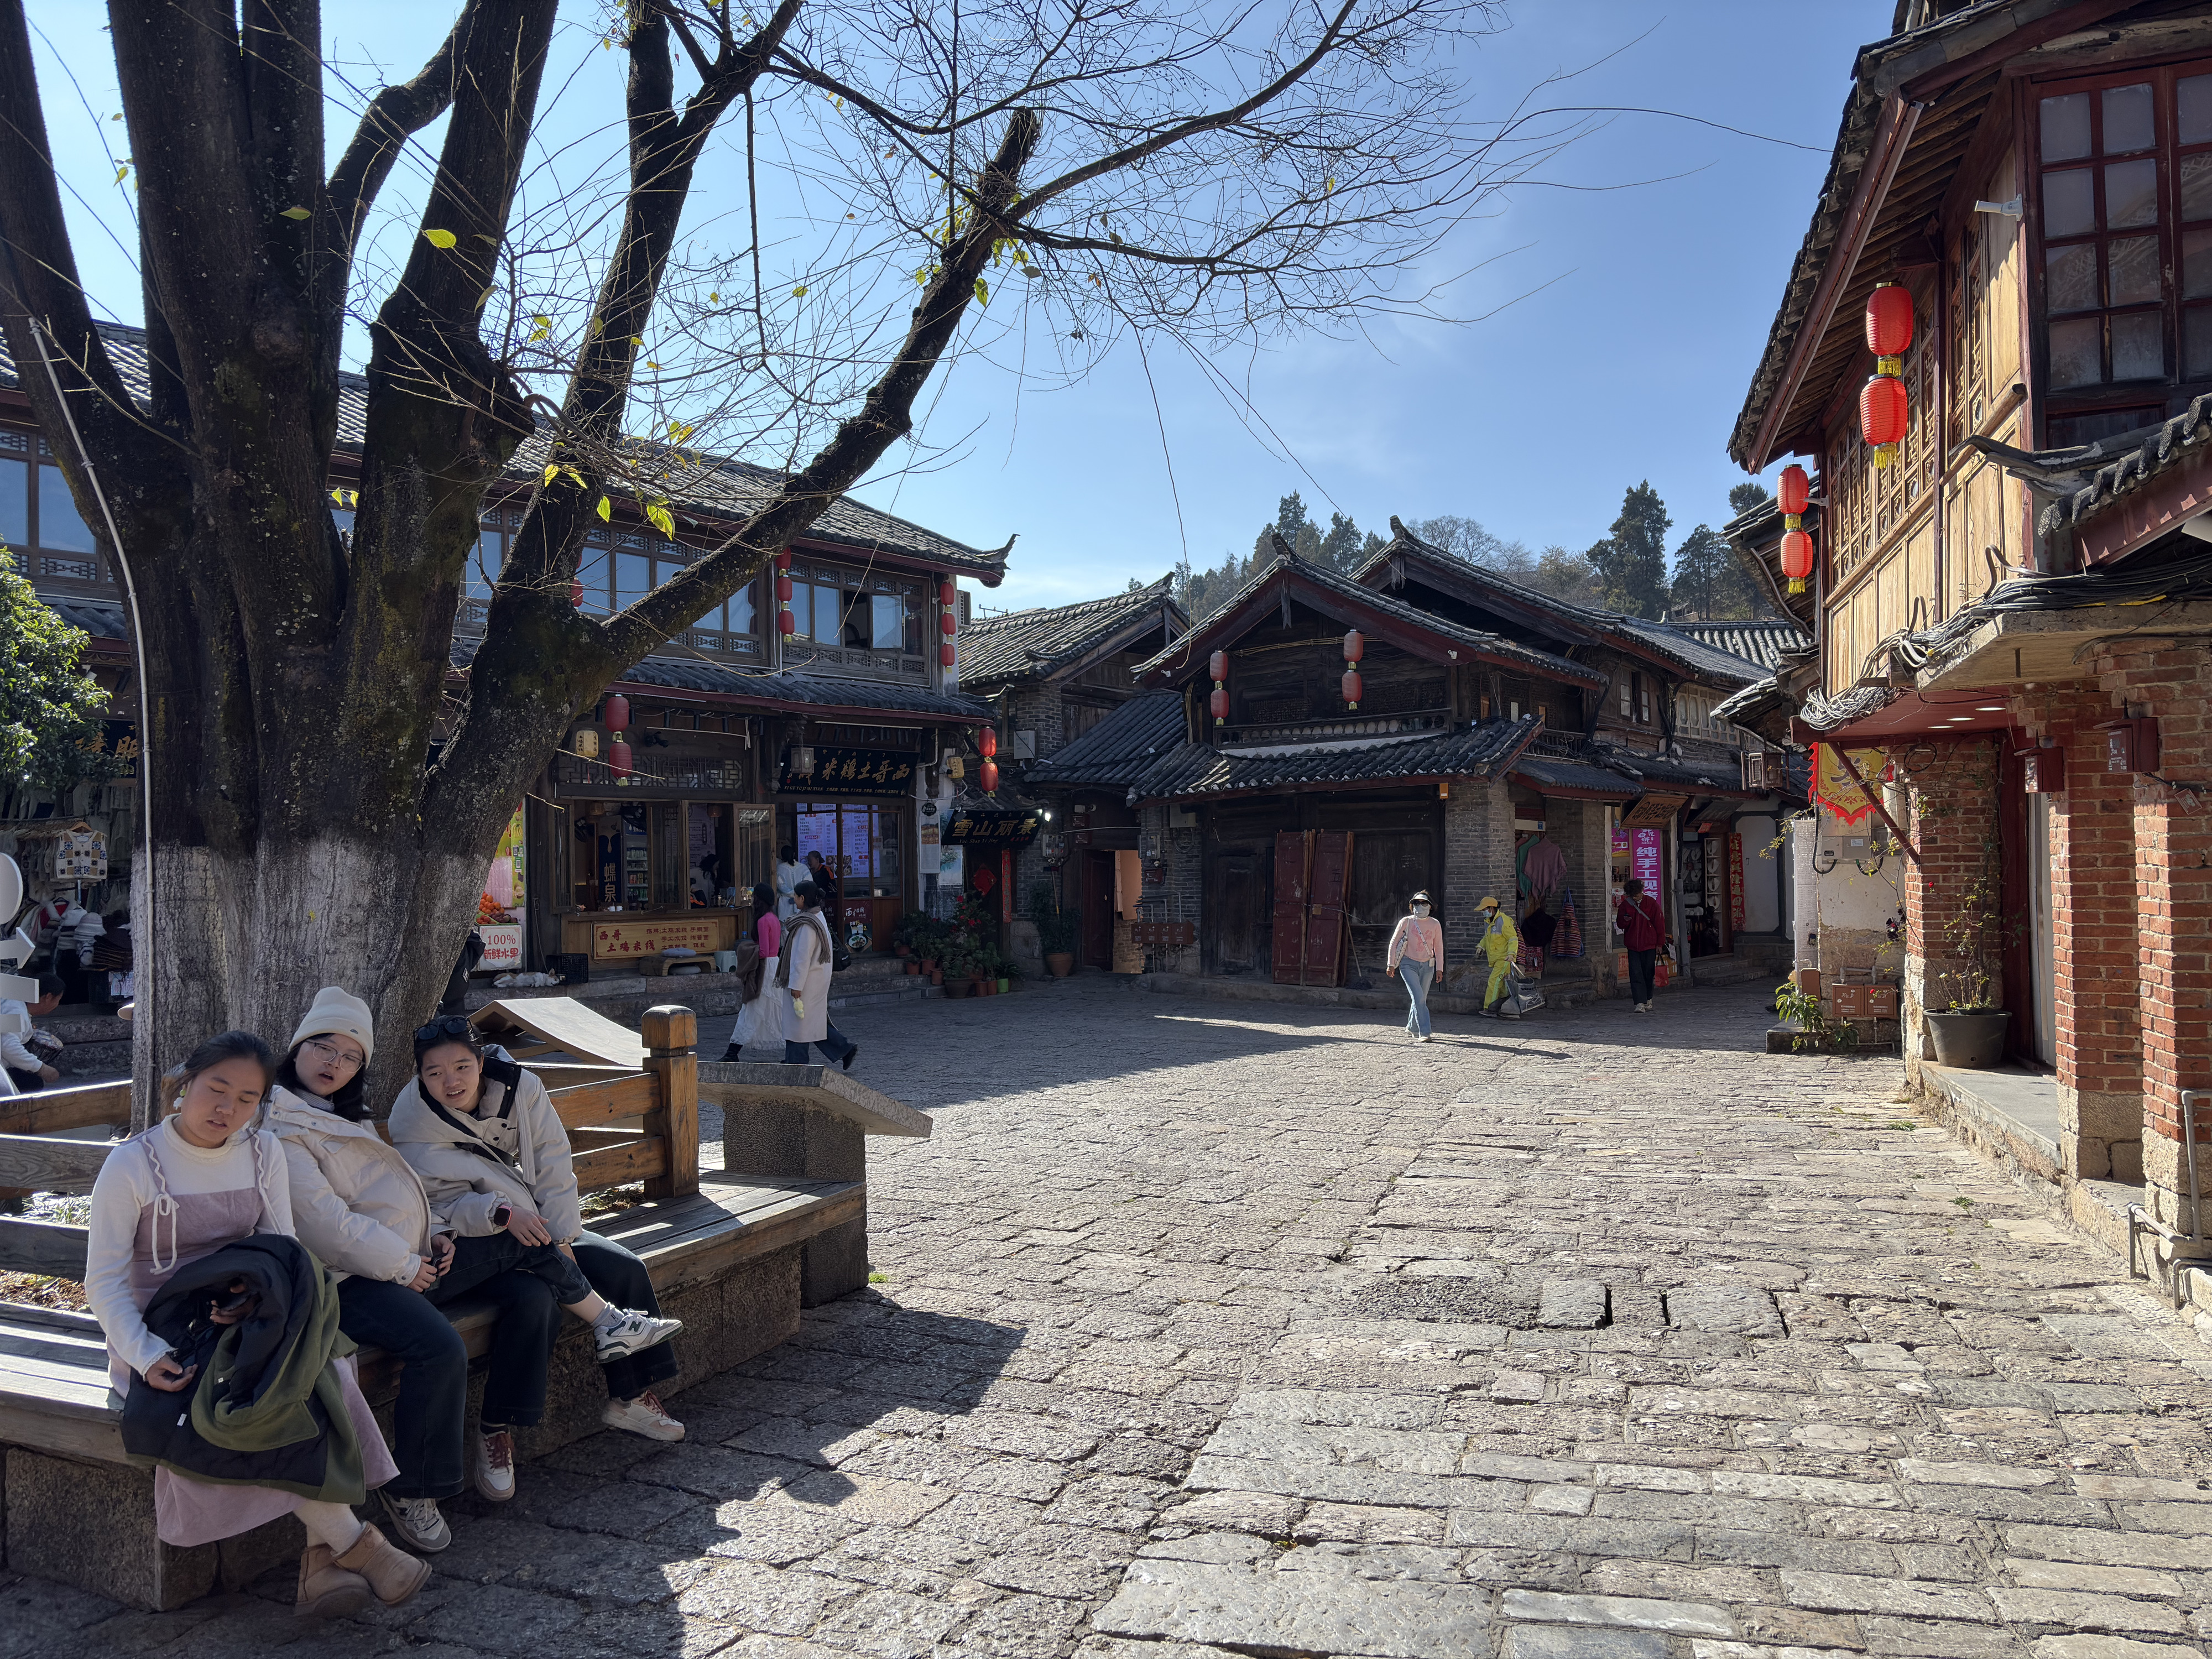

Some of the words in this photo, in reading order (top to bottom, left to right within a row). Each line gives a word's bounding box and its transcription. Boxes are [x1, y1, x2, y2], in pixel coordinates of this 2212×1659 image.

[952, 818, 1037, 837] 雪山丽景
[604, 863, 617, 902] 蝶泉
[488, 935, 516, 945] 100%
[599, 929, 622, 941] 西哥
[607, 940, 655, 952] 土鸡米线
[484, 947, 519, 959] 新鲜水果
[628, 1321, 642, 1332] N
